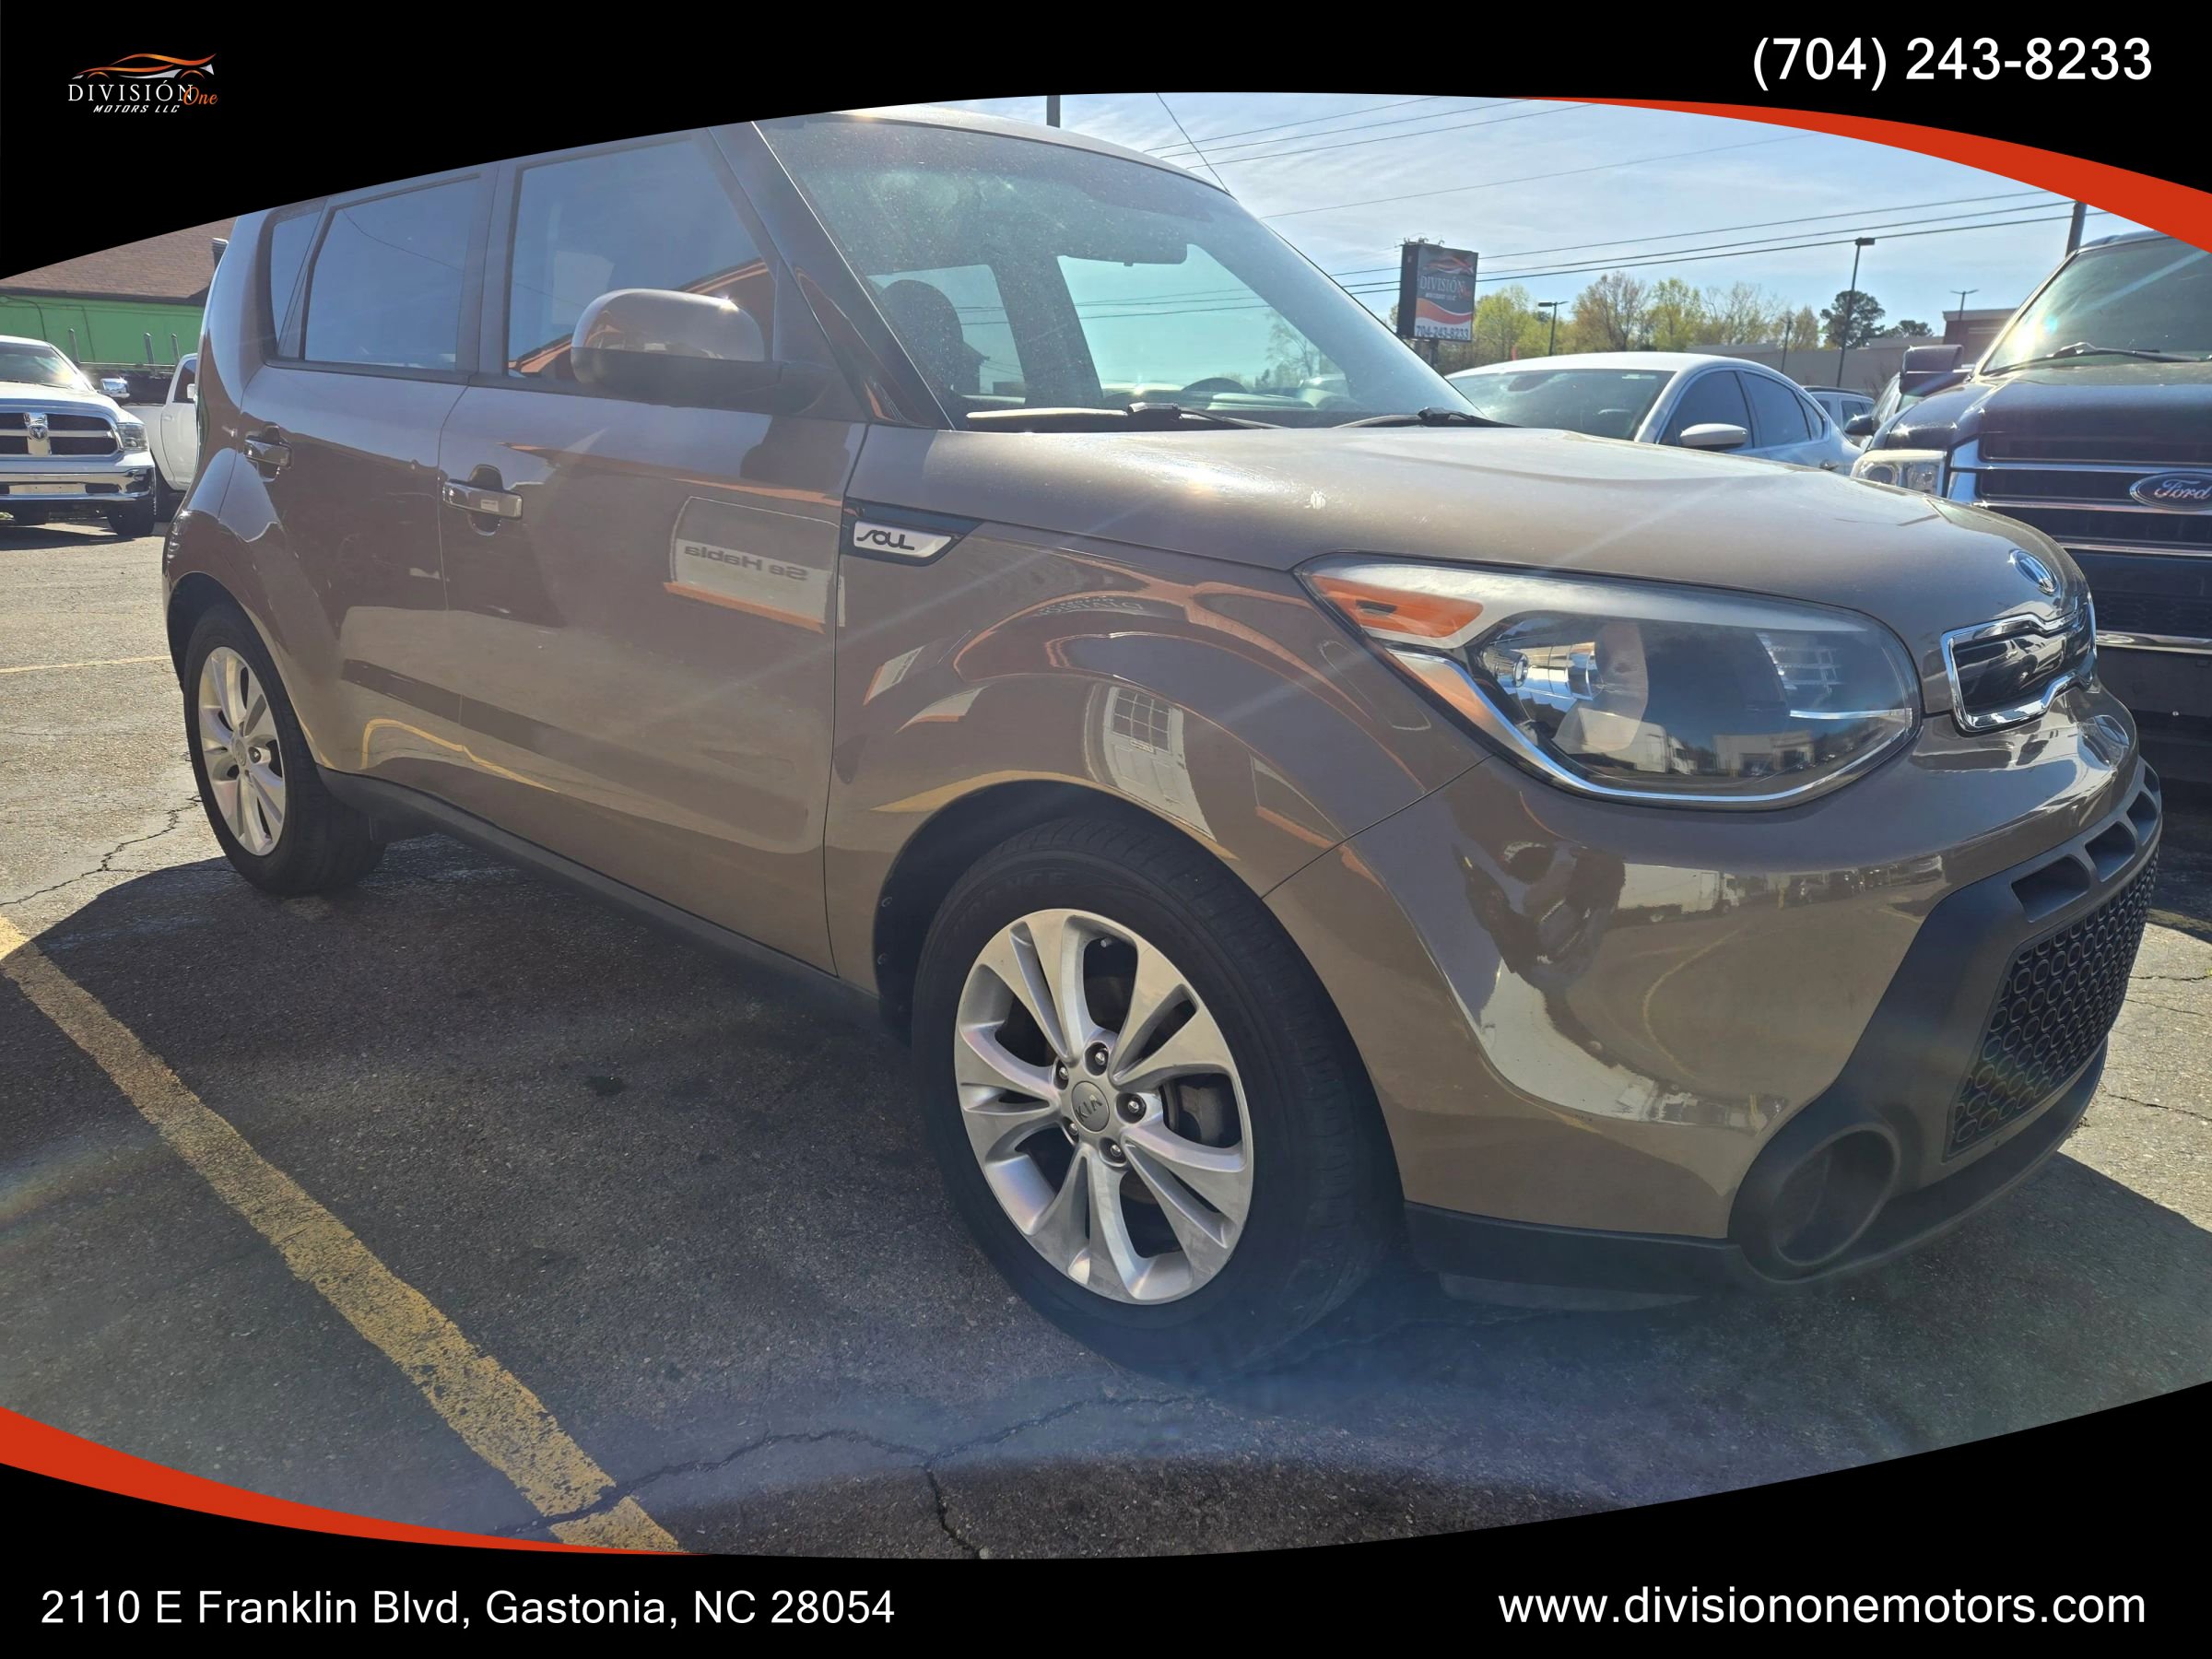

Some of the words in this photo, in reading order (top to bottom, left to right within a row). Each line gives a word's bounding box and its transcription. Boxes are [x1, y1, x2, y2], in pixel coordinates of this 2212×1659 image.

[2153, 478, 2212, 500] Ford
[855, 529, 915, 551] SOUL
[1075, 1094, 1103, 1123] KIA
